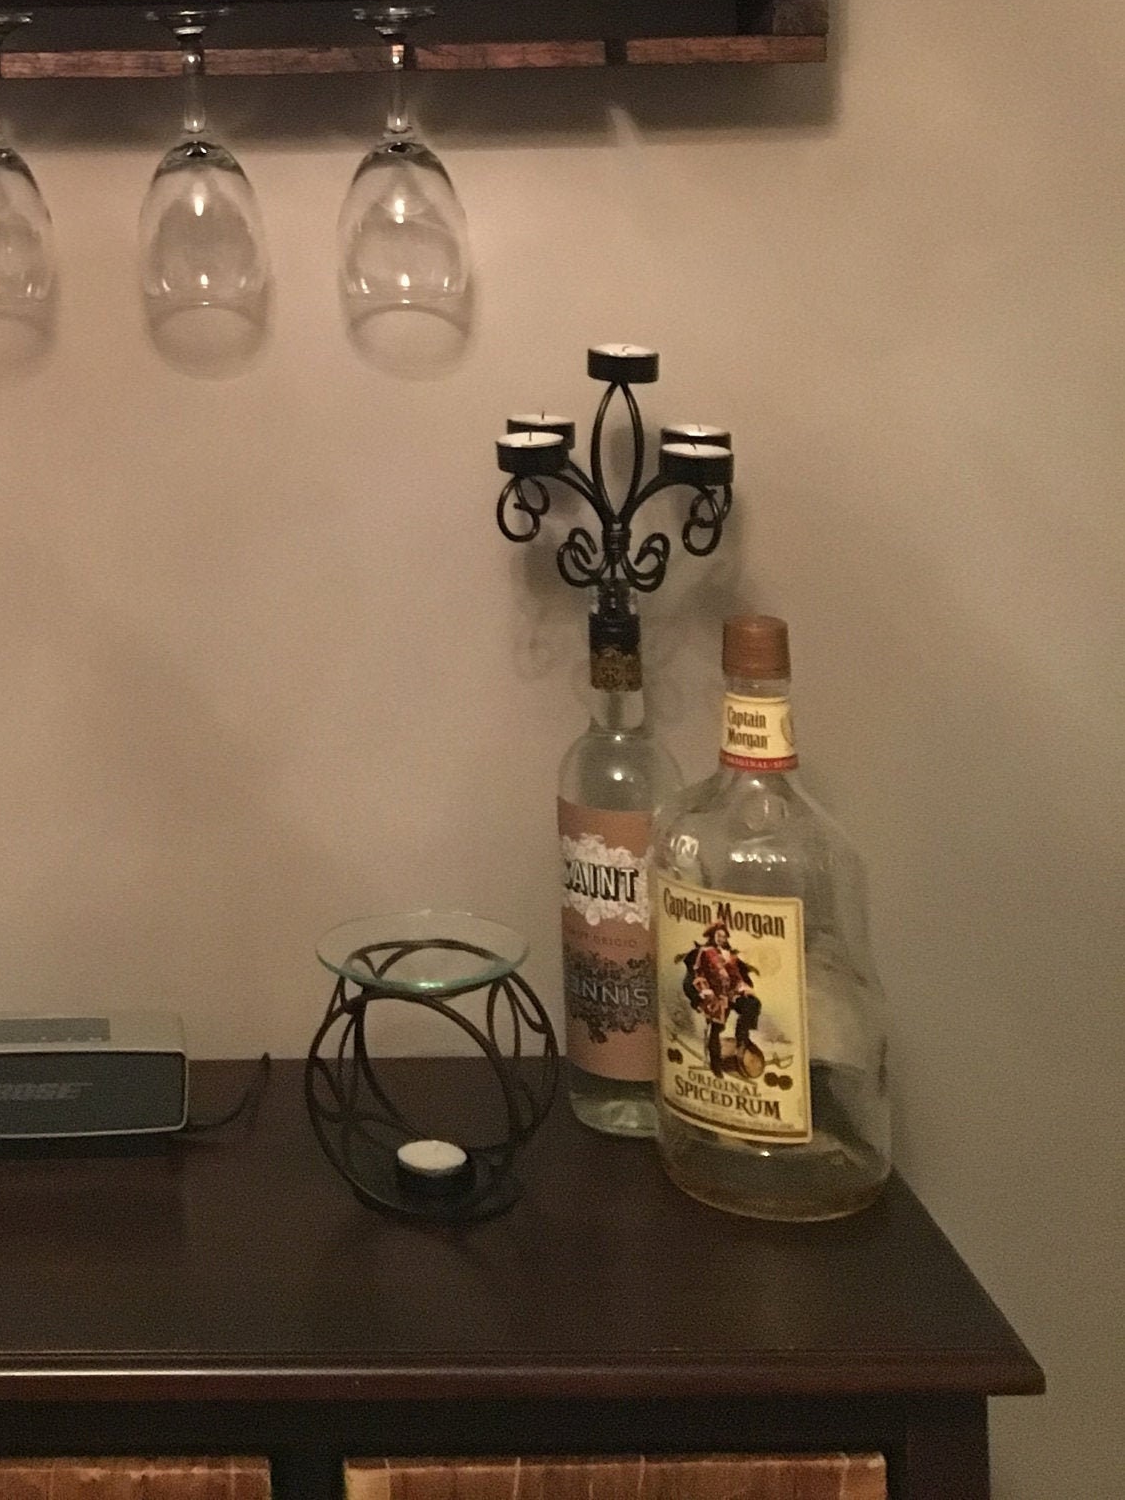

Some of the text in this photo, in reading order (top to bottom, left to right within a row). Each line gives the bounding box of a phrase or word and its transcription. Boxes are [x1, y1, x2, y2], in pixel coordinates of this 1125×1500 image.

[727, 705, 767, 729] Captain
[727, 727, 769, 751] Morgan
[663, 887, 786, 940] Captain Morgan
[688, 1070, 762, 1098] ORIGINAL
